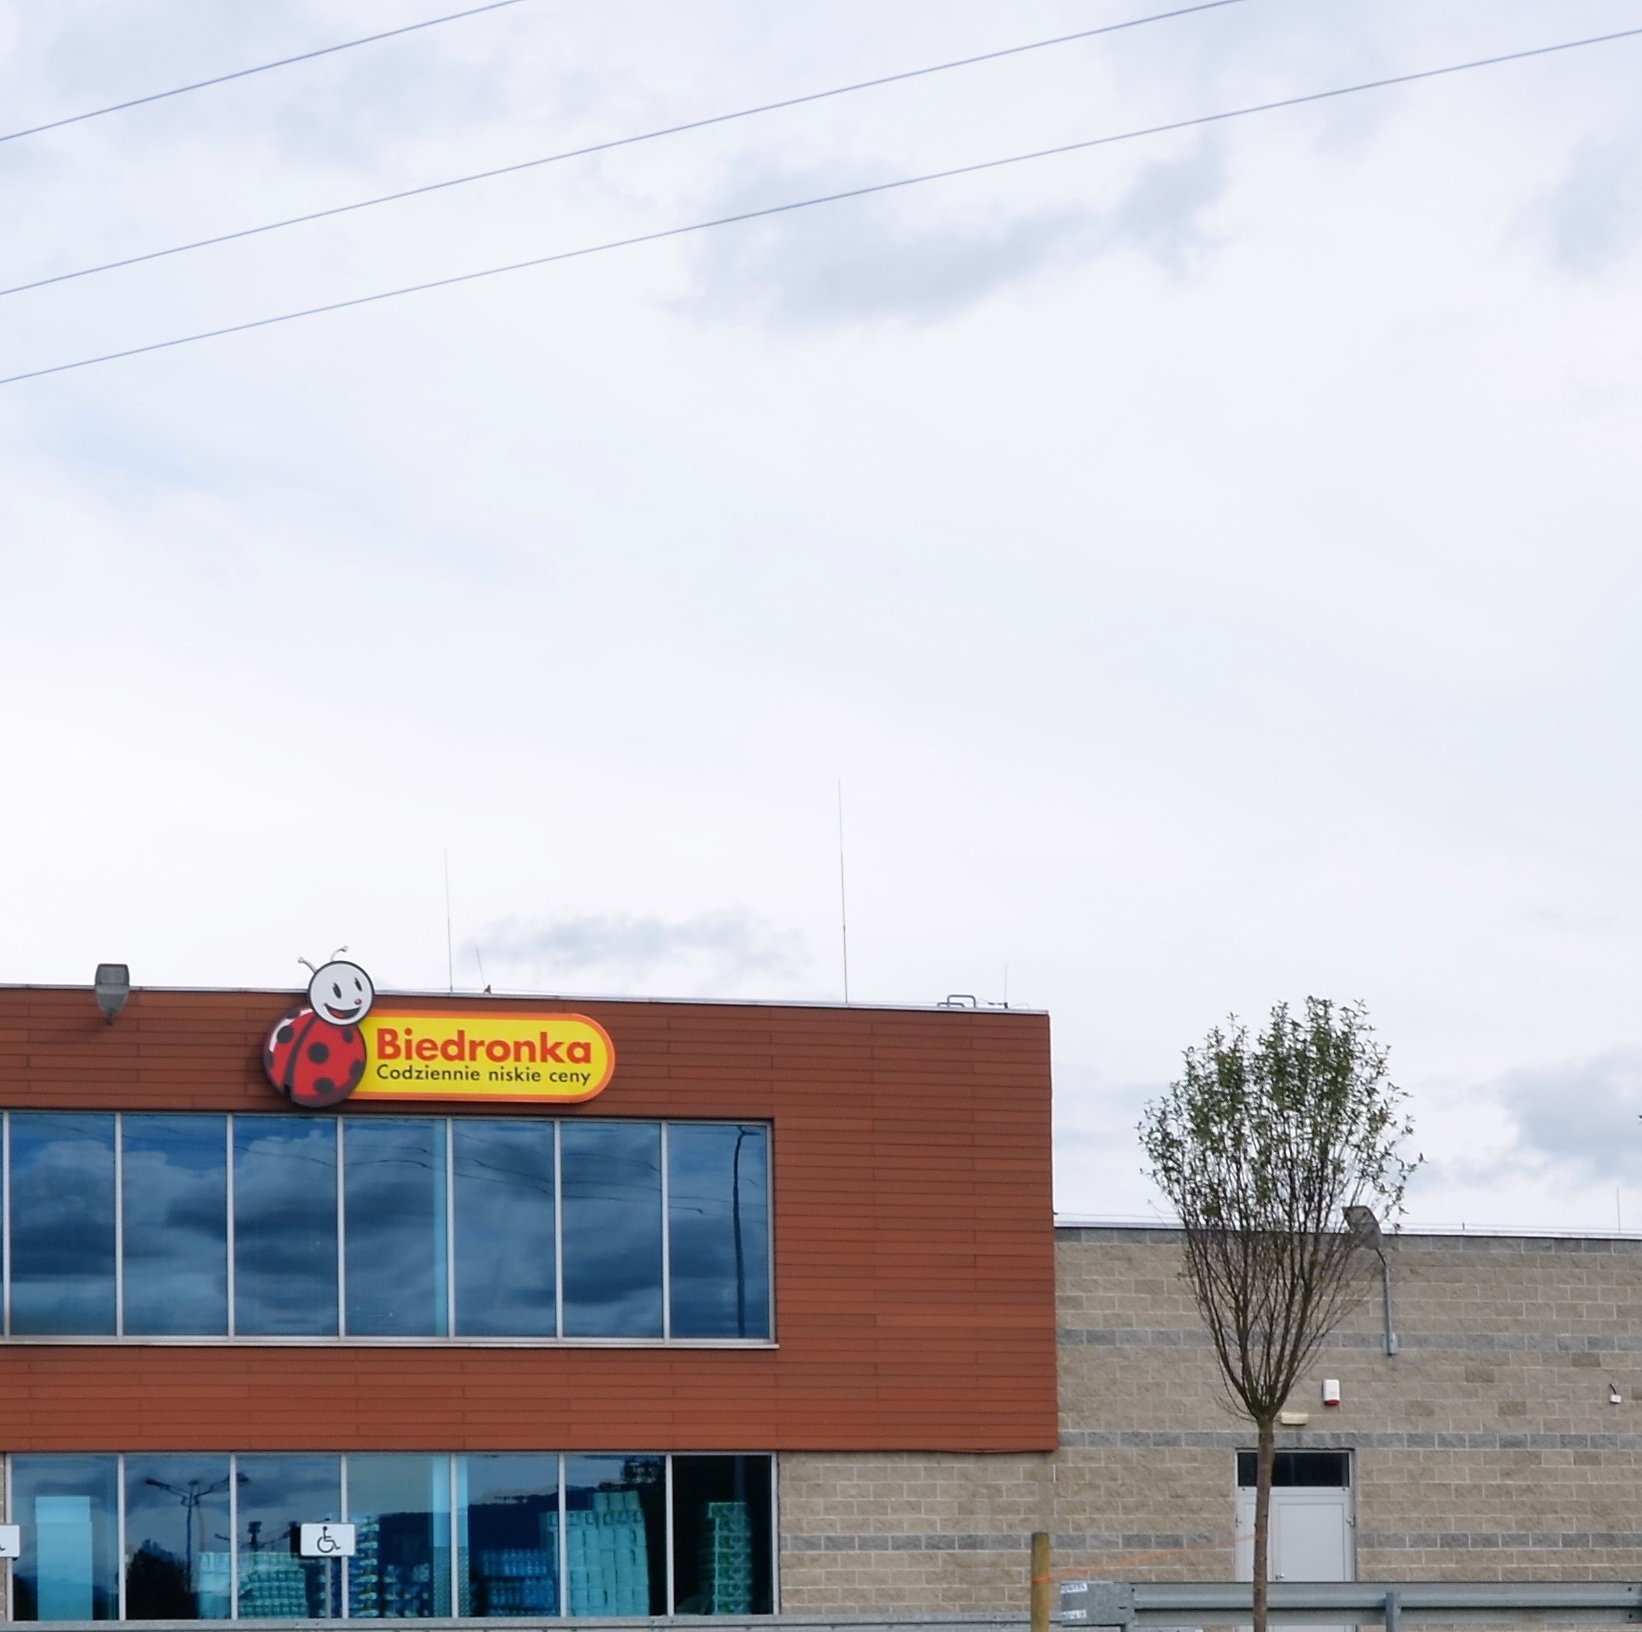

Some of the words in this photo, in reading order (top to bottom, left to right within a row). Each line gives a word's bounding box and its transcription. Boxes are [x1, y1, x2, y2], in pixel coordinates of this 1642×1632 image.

[376, 1027, 592, 1064] Biedronka
[376, 1063, 481, 1082] Codziennie
[488, 1064, 542, 1083] niskie
[549, 1070, 592, 1087] ceny
